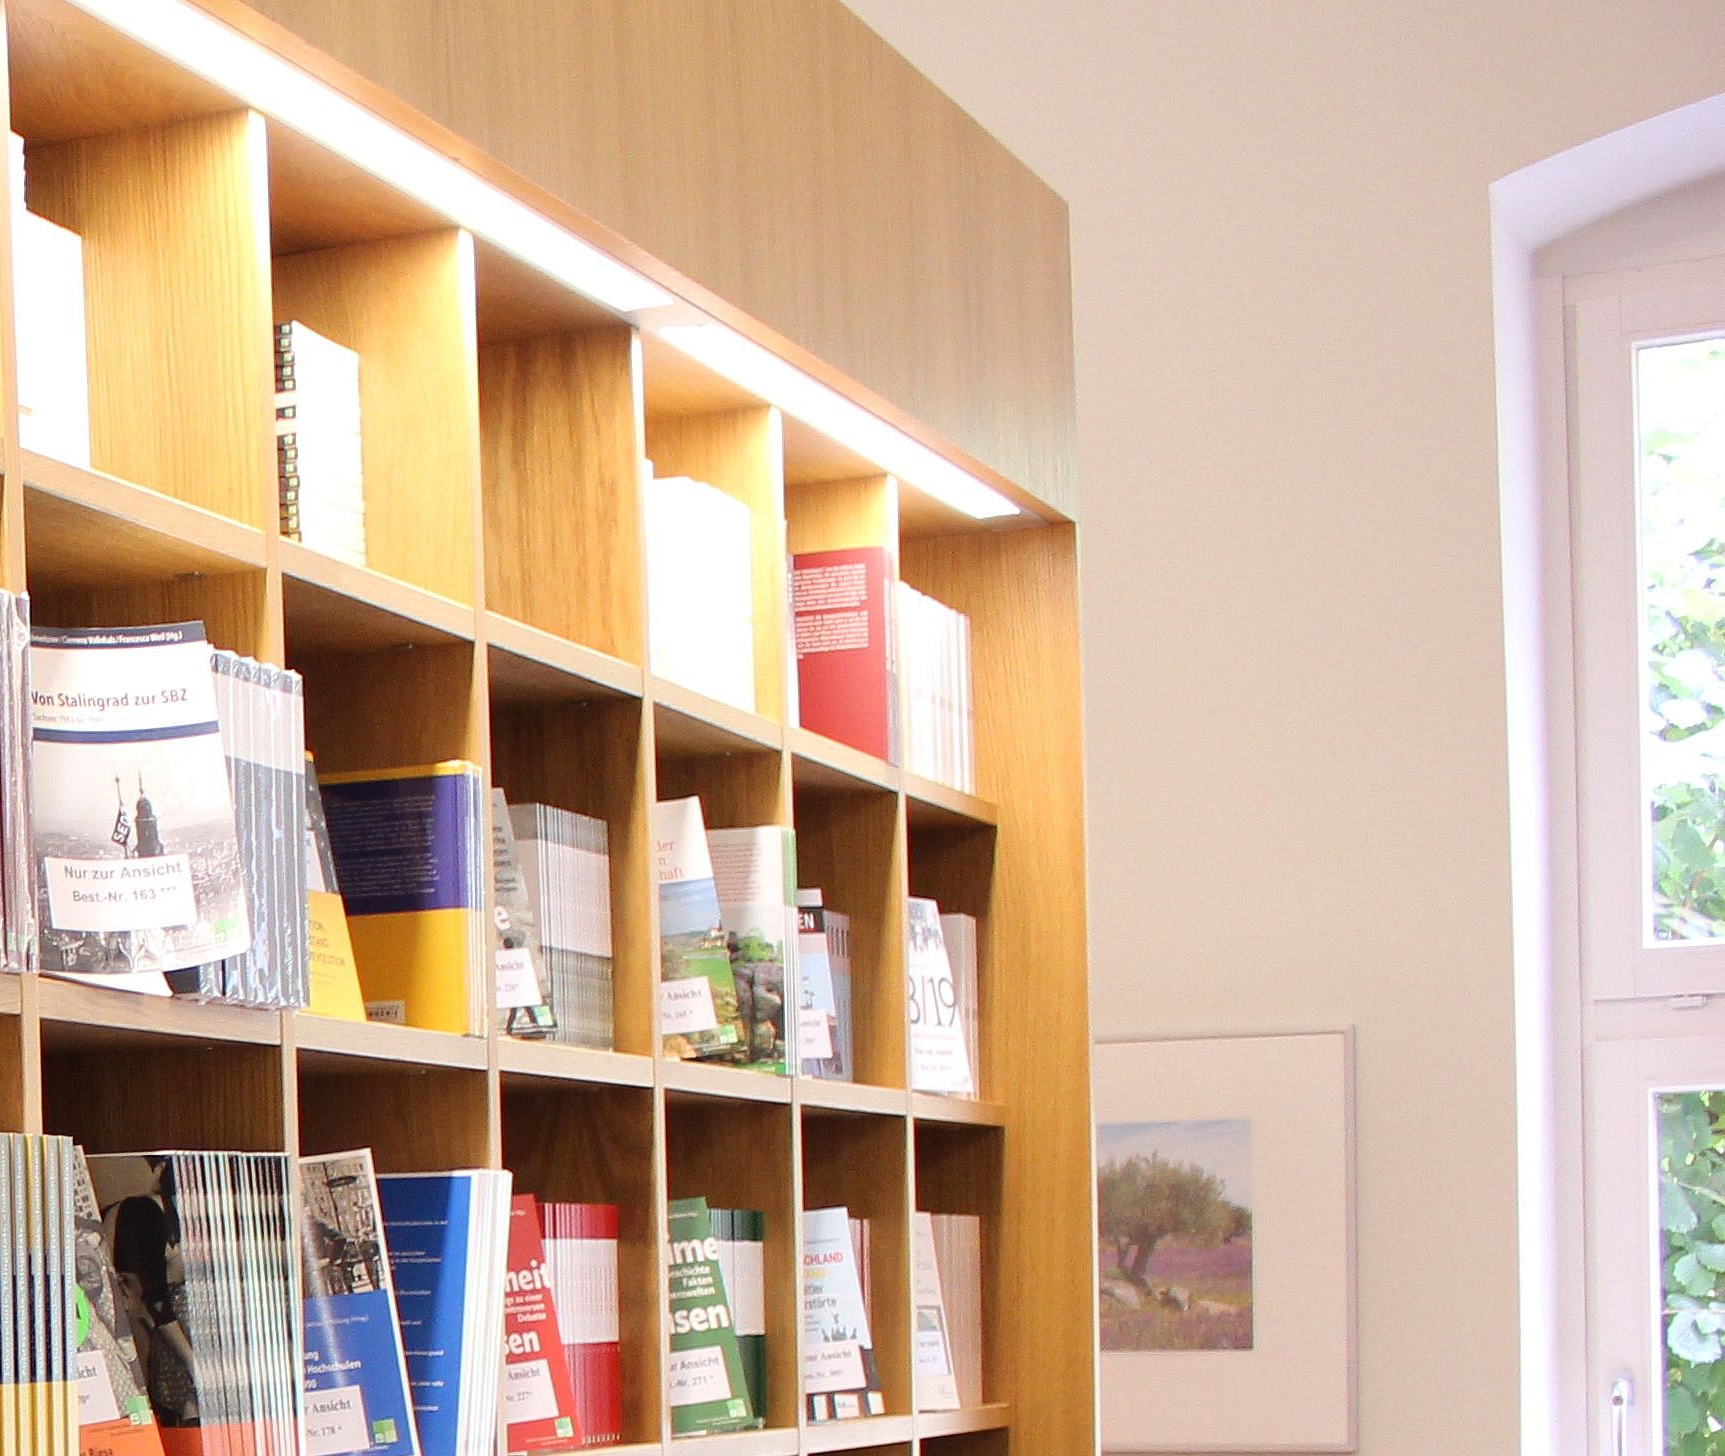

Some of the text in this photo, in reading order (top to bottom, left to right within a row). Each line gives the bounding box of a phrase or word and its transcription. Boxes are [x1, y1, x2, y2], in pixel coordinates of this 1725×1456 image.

[31, 688, 188, 711] Von Stalingrad zur SBZ
[64, 861, 182, 880] Nur zur Ansicht
[72, 887, 157, 903] Best.-Nr. 163
[680, 1357, 719, 1370] Ansicht
[311, 1400, 352, 1415] Ansicht
